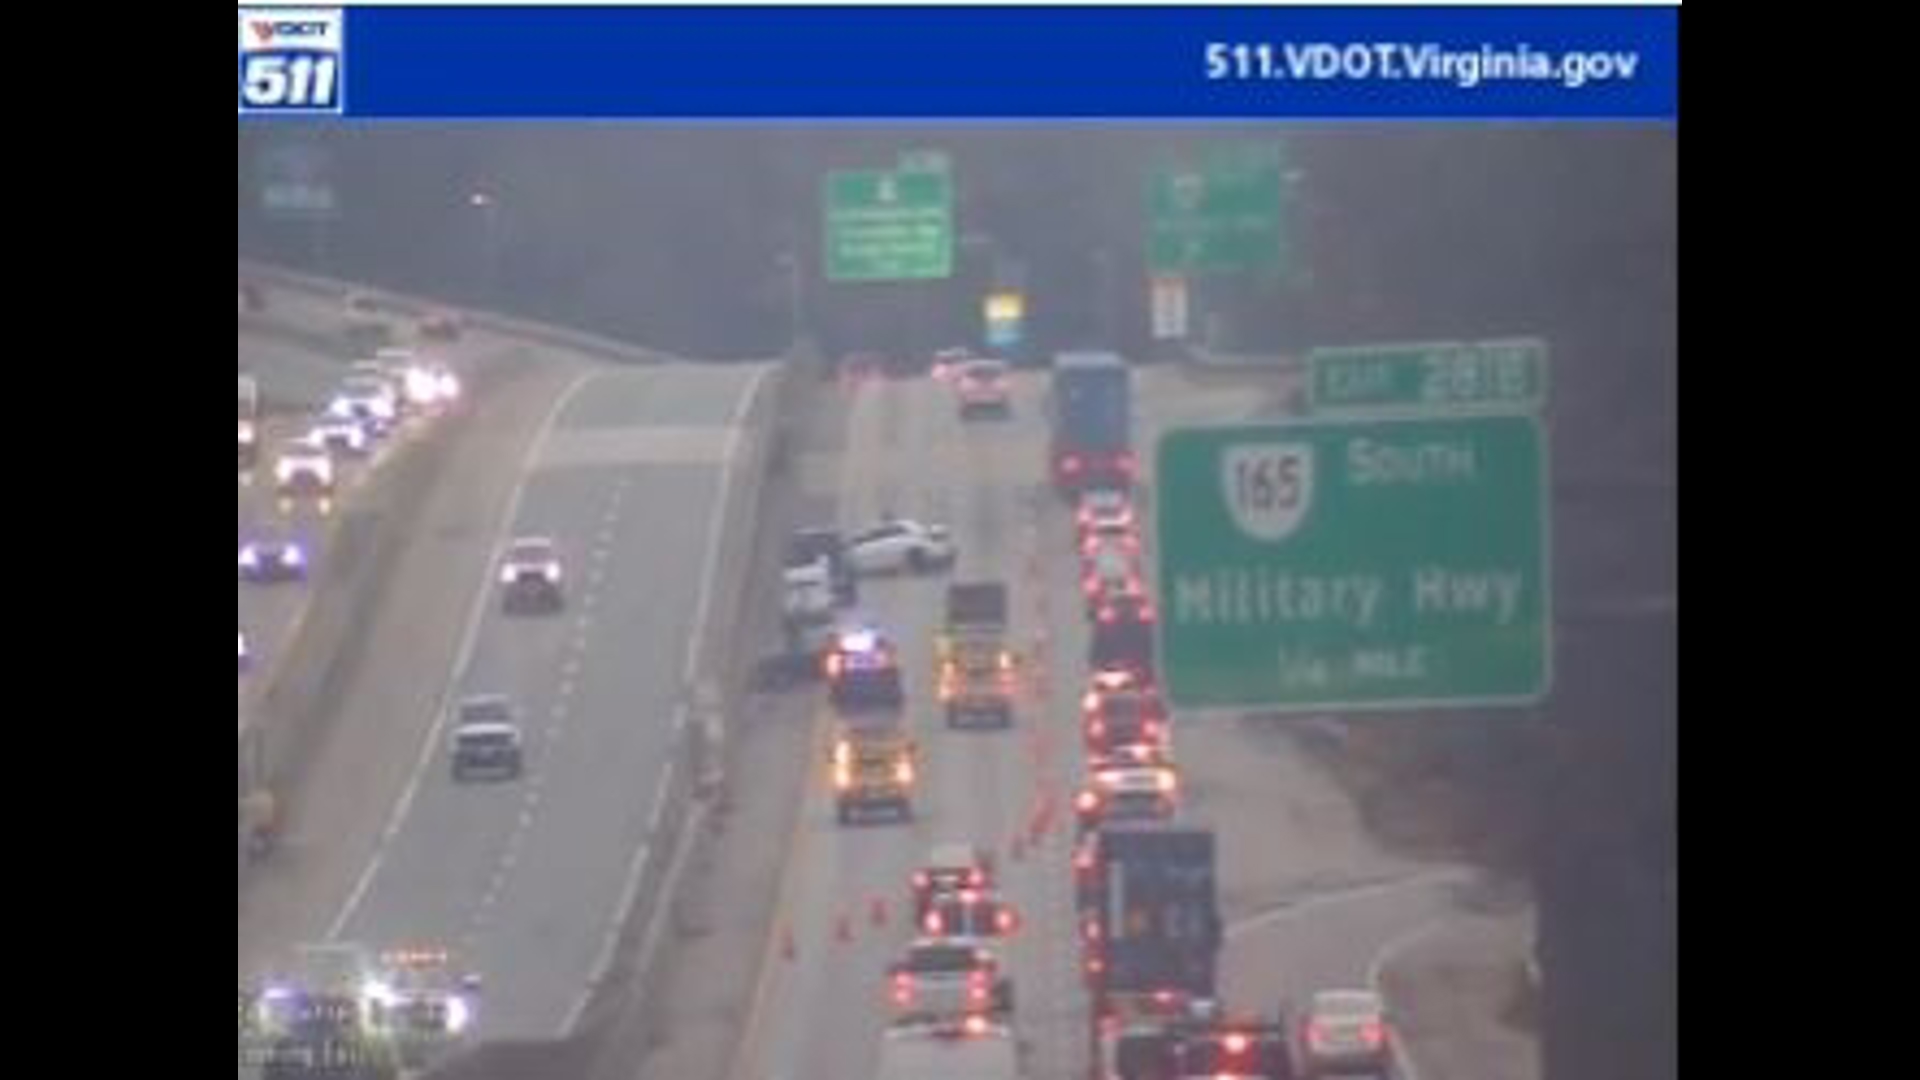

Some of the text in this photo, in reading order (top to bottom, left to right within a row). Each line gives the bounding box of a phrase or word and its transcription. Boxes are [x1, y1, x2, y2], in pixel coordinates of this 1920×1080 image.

[1234, 455, 1300, 513] 165
[1174, 567, 1521, 628] Military Hwy
